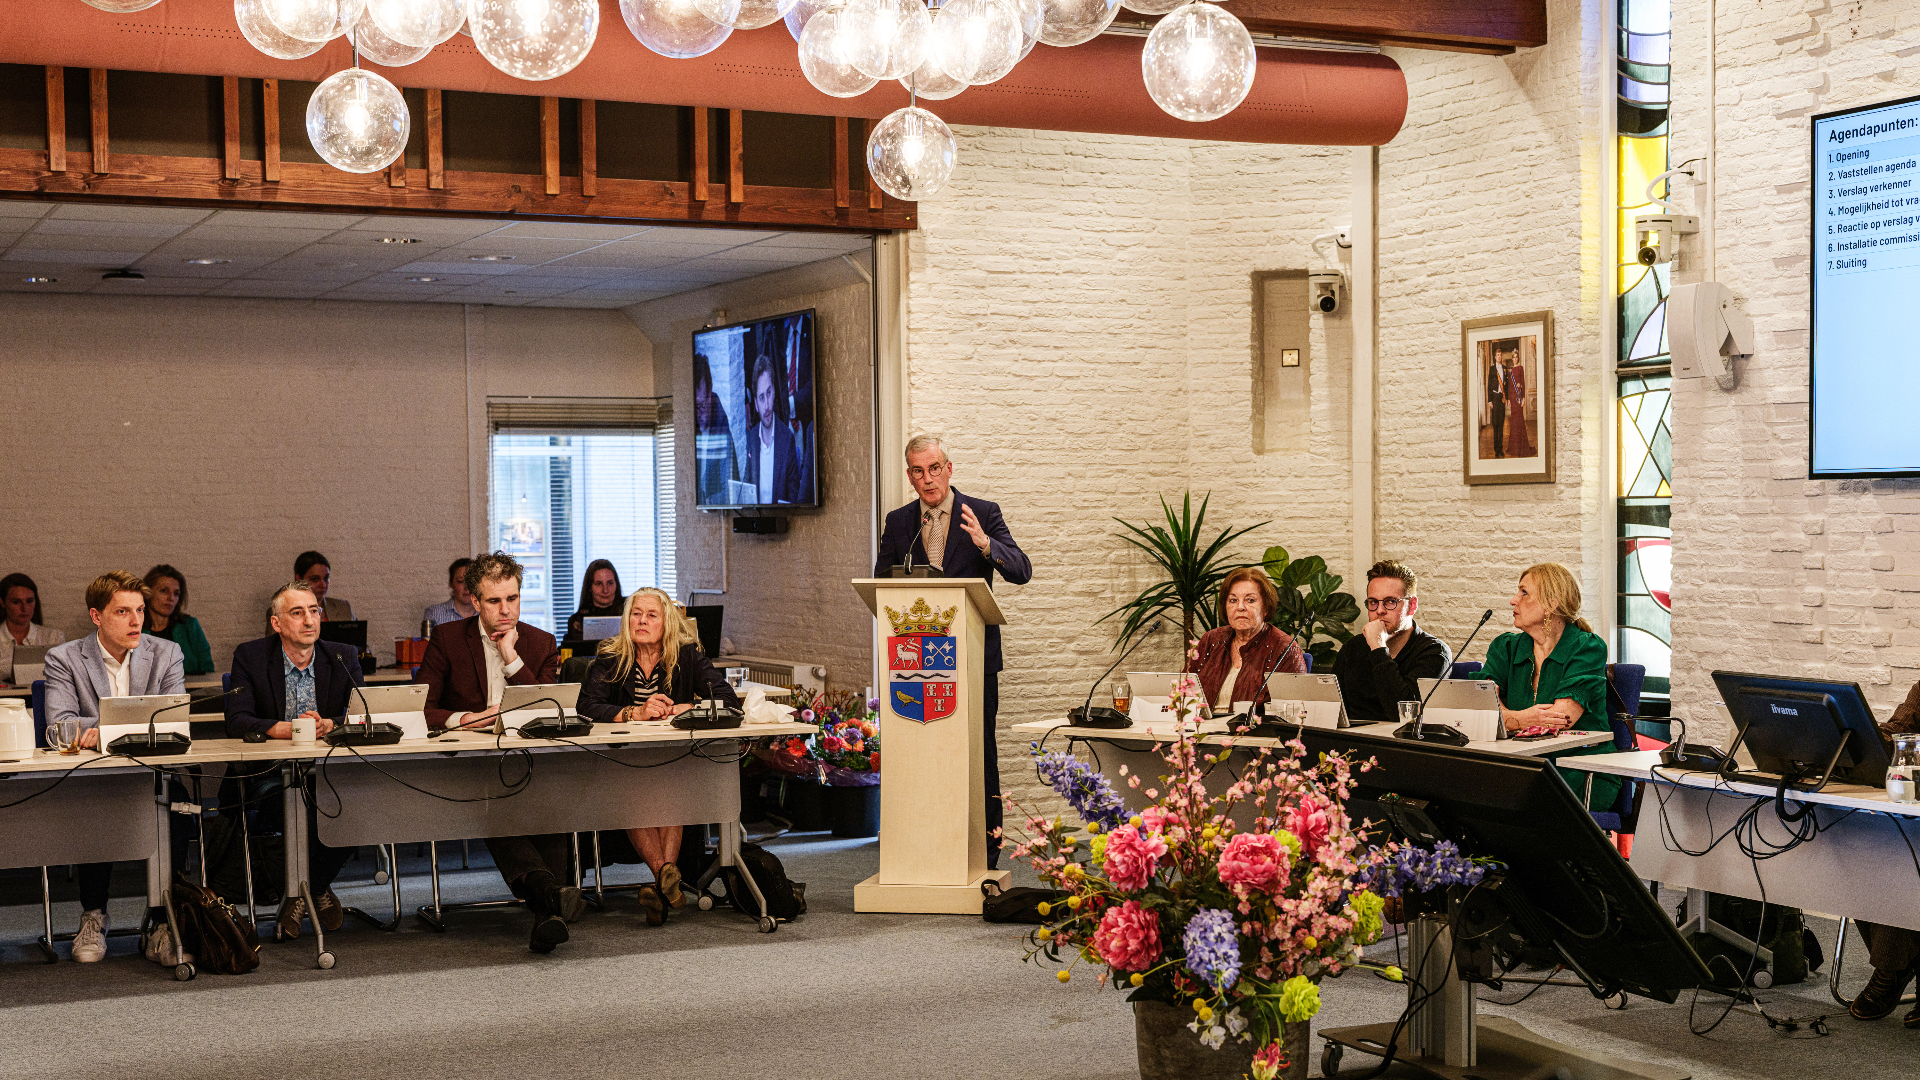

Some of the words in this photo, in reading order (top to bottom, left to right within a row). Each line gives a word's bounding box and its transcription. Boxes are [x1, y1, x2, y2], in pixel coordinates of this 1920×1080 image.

[1828, 118, 1918, 143] Agendapunten:
[1828, 154, 1834, 163] 1.
[1836, 149, 1870, 163] Opening
[1828, 172, 1836, 181] 2.
[1838, 164, 1884, 179] Vaststellen
[1886, 159, 1916, 173] agenda
[1828, 190, 1836, 199] 3.
[1838, 186, 1868, 197] Verslag
[1870, 179, 1912, 192] verkenner
[1828, 208, 1836, 216] 4.
[1838, 199, 1889, 216] Mogelijkheid
[1891, 198, 1903, 207] tot
[1828, 226, 1836, 234] 5.
[1838, 221, 1868, 233] Reactie
[1870, 221, 1880, 230] op
[1883, 216, 1913, 227] verslag
[1828, 243, 1835, 252] 6.
[1838, 238, 1877, 251] Installatie
[1828, 261, 1834, 270] 7.
[1836, 258, 1867, 269] Sluiting
